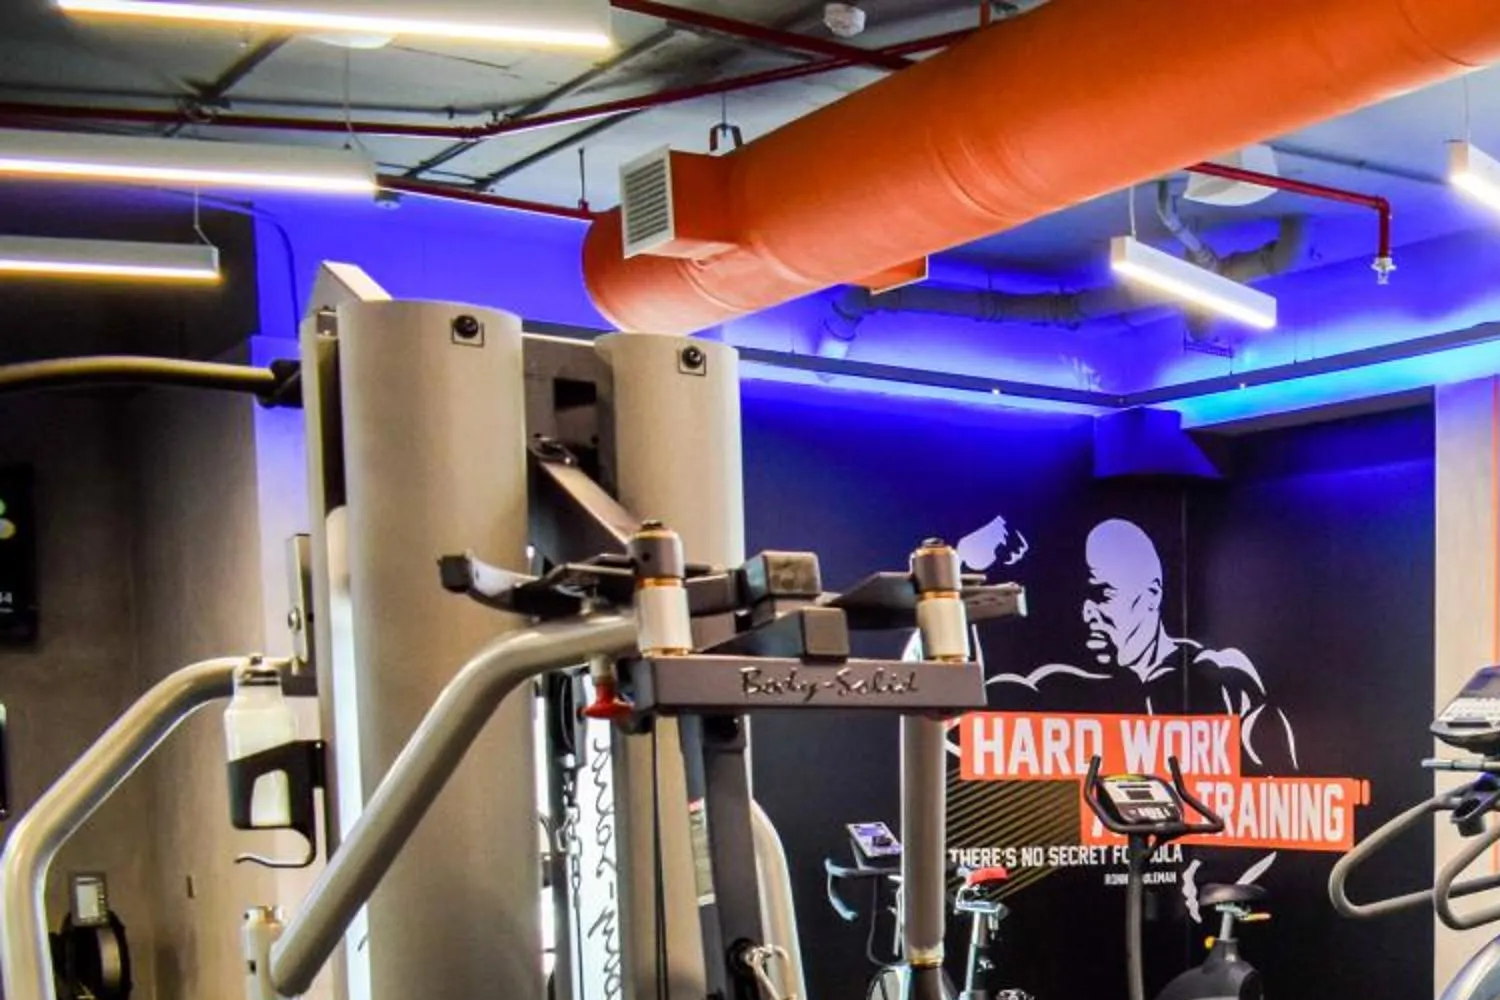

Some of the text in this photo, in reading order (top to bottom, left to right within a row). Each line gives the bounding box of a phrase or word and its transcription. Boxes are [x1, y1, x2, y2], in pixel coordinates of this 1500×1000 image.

[740, 666, 921, 702] Body-Solid
[973, 716, 1233, 776] HARD WORK
[1196, 781, 1345, 841] TRAINING
[949, 843, 1183, 867] THERE'S NO SECRET FOULA
